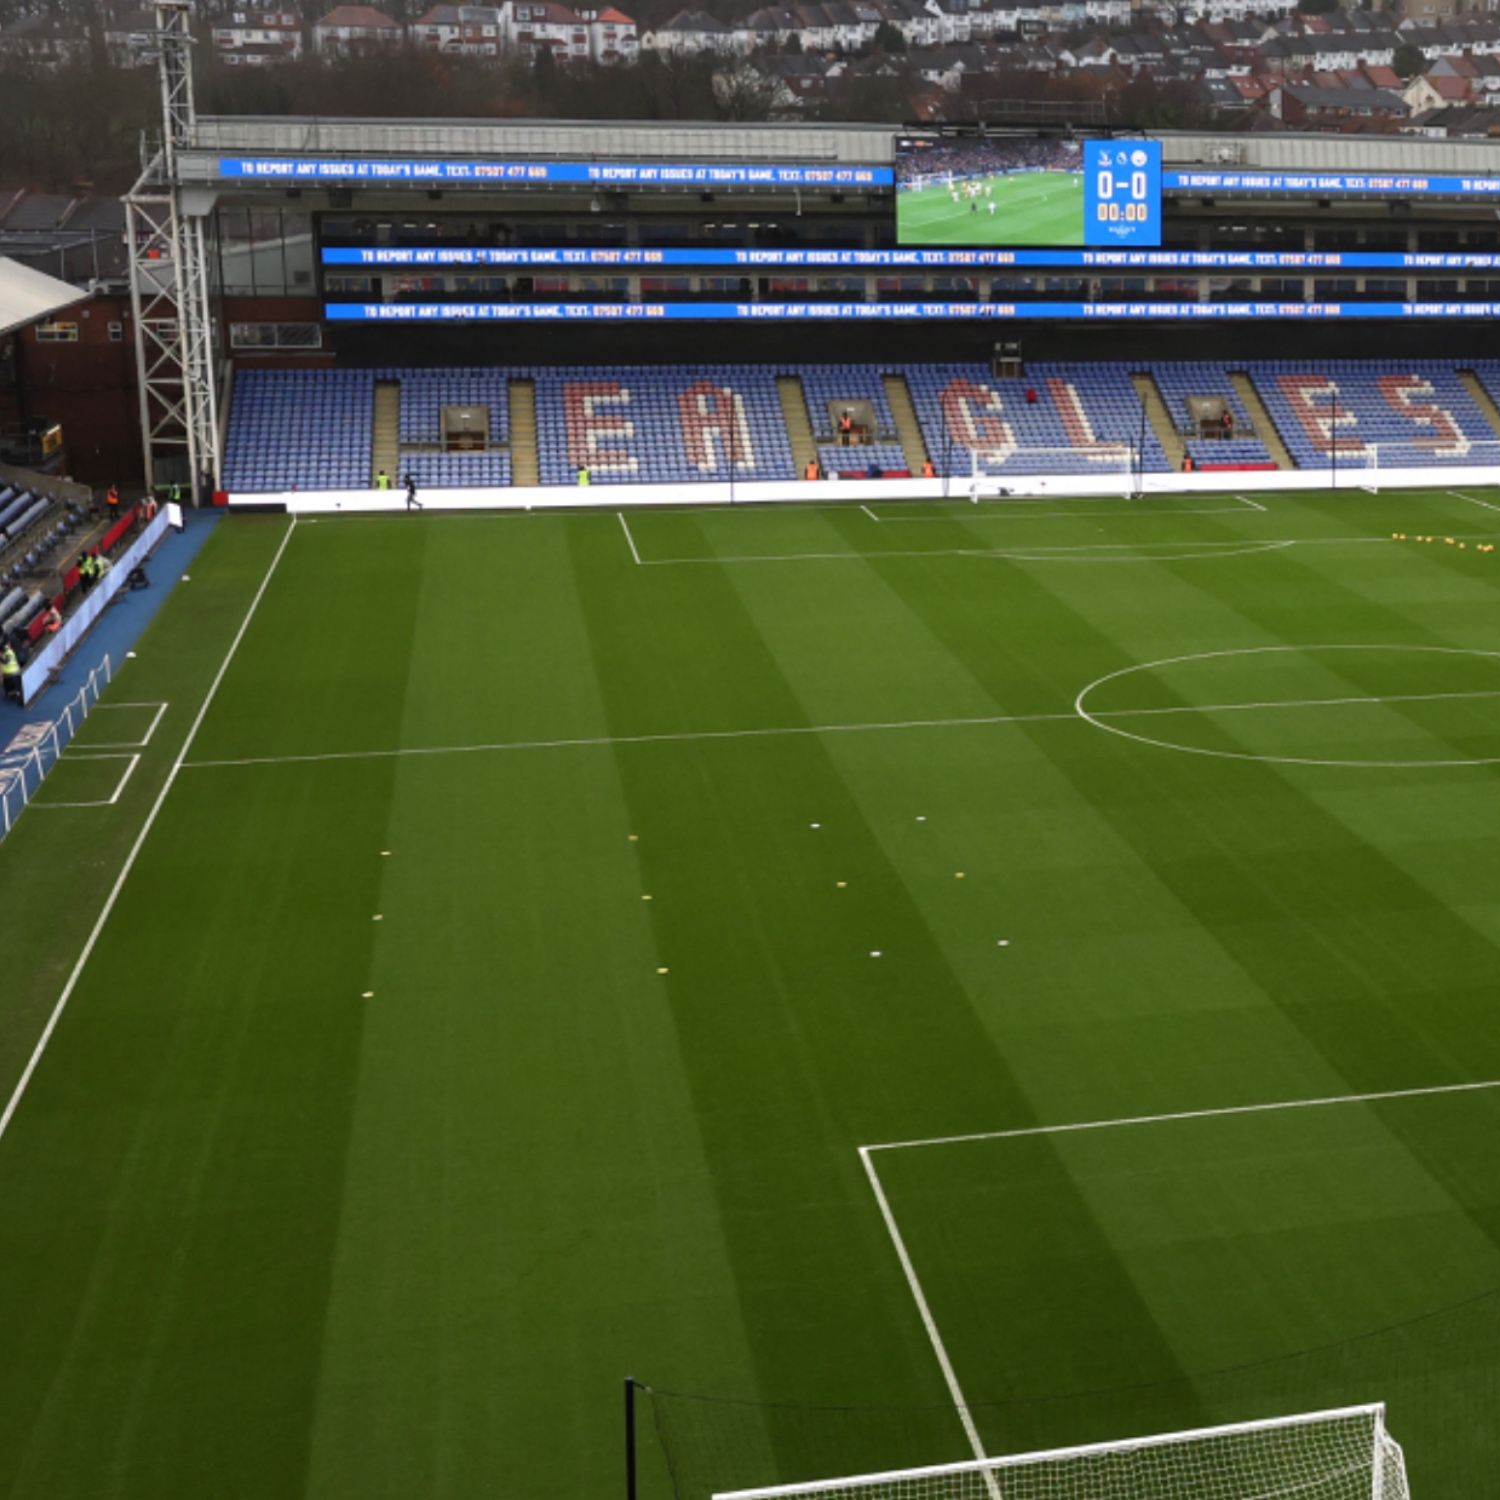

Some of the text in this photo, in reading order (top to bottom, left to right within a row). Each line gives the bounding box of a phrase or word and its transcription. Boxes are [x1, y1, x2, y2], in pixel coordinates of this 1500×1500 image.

[242, 162, 255, 173] TO
[256, 163, 293, 174] REPORT
[296, 163, 317, 174] ANY
[319, 164, 355, 174] ISSUES
[357, 164, 368, 175] AT
[371, 164, 411, 175] TODAY'S
[589, 167, 601, 178] TO
[602, 168, 637, 178] REPORT
[639, 168, 658, 179] ANY
[660, 168, 694, 179] ISSUES
[695, 169, 706, 179] AT
[709, 169, 746, 180] TODAY'S
[1179, 176, 1189, 186] TO
[1190, 176, 1221, 186] REPORT
[1223, 176, 1240, 186] ANY
[1241, 177, 1271, 187] ISSUES
[1272, 177, 1282, 187] AT
[1462, 181, 1472, 190] TO
[1098, 203, 1147, 221] 00:00
[362, 250, 374, 262] TO
[376, 250, 413, 262] REPORT
[416, 250, 435, 262] ANY
[438, 251, 473, 262] ISSUES
[489, 251, 528, 262] TODAY'S
[736, 252, 747, 262] TO
[749, 252, 783, 262] REPORT
[786, 252, 804, 262] ANY
[806, 252, 838, 262] ISSUES
[841, 252, 852, 262] AT
[854, 252, 890, 262] TODAY'S
[1083, 253, 1094, 263] TO
[1095, 253, 1127, 263] REPORT
[1129, 253, 1146, 263] ANY
[1148, 253, 1178, 264] ISSUES
[1179, 253, 1190, 264] AT
[1404, 255, 1415, 265] TO
[1414, 255, 1444, 265] REPORT
[1446, 255, 1463, 265] ANY
[365, 306, 378, 317] TO
[379, 306, 416, 317] REPORT
[419, 306, 438, 317] ANY
[440, 306, 476, 317] ISSUES
[478, 306, 489, 317] AT
[491, 306, 531, 317] TODAY'S
[737, 305, 750, 316] TO
[750, 305, 785, 316] REPORT
[786, 305, 806, 316] ANY
[807, 305, 840, 316] ISSUES
[842, 305, 852, 315] AT
[855, 305, 891, 315] TODAY'S
[1084, 304, 1094, 315] TO
[1094, 304, 1127, 315] REPORT
[1129, 304, 1147, 315] ANY
[1148, 304, 1178, 315] ISSUES
[1179, 304, 1190, 315] AT
[1403, 304, 1413, 314] TO
[1413, 304, 1444, 314] REPORT
[1445, 304, 1462, 314] ANY
